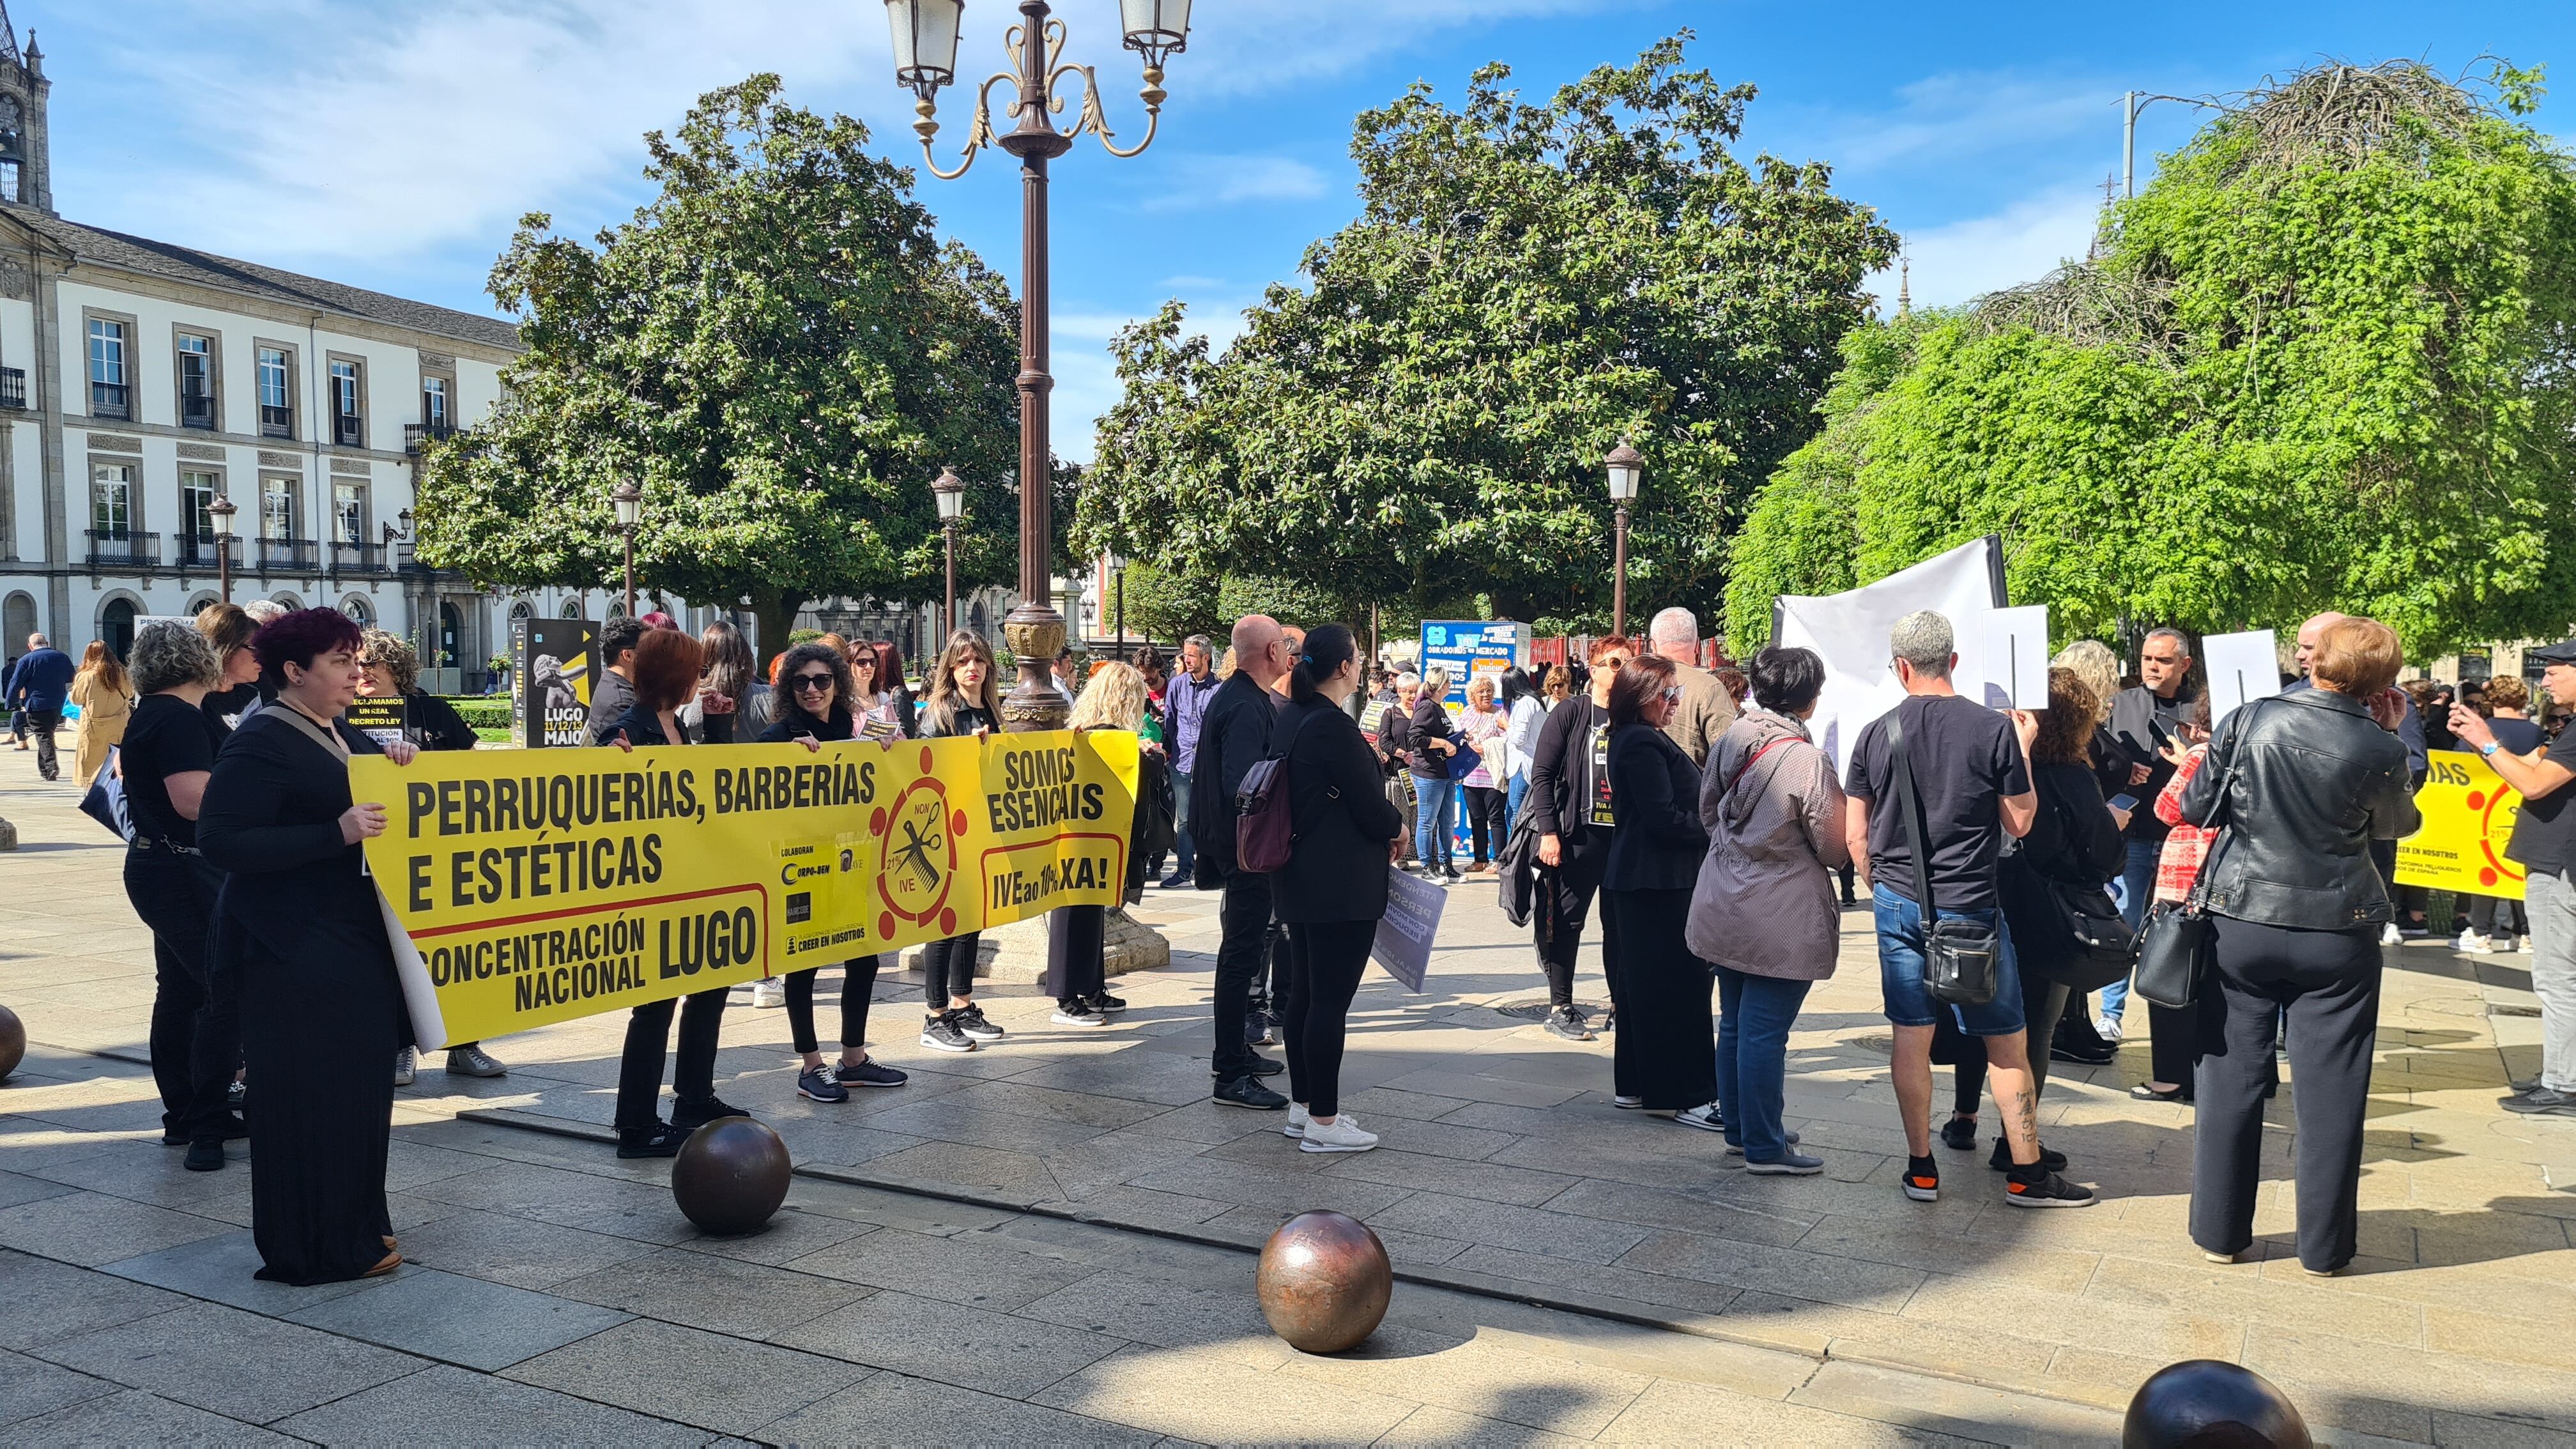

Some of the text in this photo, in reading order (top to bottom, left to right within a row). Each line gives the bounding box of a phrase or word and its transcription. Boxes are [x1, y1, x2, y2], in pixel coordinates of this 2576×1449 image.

[1476, 647, 1508, 656] MERCADO
[544, 707, 583, 722] LUGO
[544, 721, 583, 731] 11/12/13
[544, 730, 581, 745] MAIO
[407, 753, 875, 838] PERRUQUERÍAS, BARBERÍAS
[914, 802, 930, 815] NON
[2490, 830, 2509, 839] 21%
[781, 845, 813, 857] COLABORAN
[2412, 847, 2421, 855] EN
[2422, 848, 2458, 860] NOSOTROS
[887, 854, 901, 870] 21%
[408, 831, 662, 912] E ESTÉTICAS
[781, 863, 830, 885] CORPO-BEN
[900, 878, 916, 894] IVE
[993, 857, 1108, 910] IVE ao 10% XA!
[659, 905, 756, 980] LUGO
[798, 926, 865, 953] CREER EN NOSOTROS
[515, 954, 646, 1012] NACIONAL
